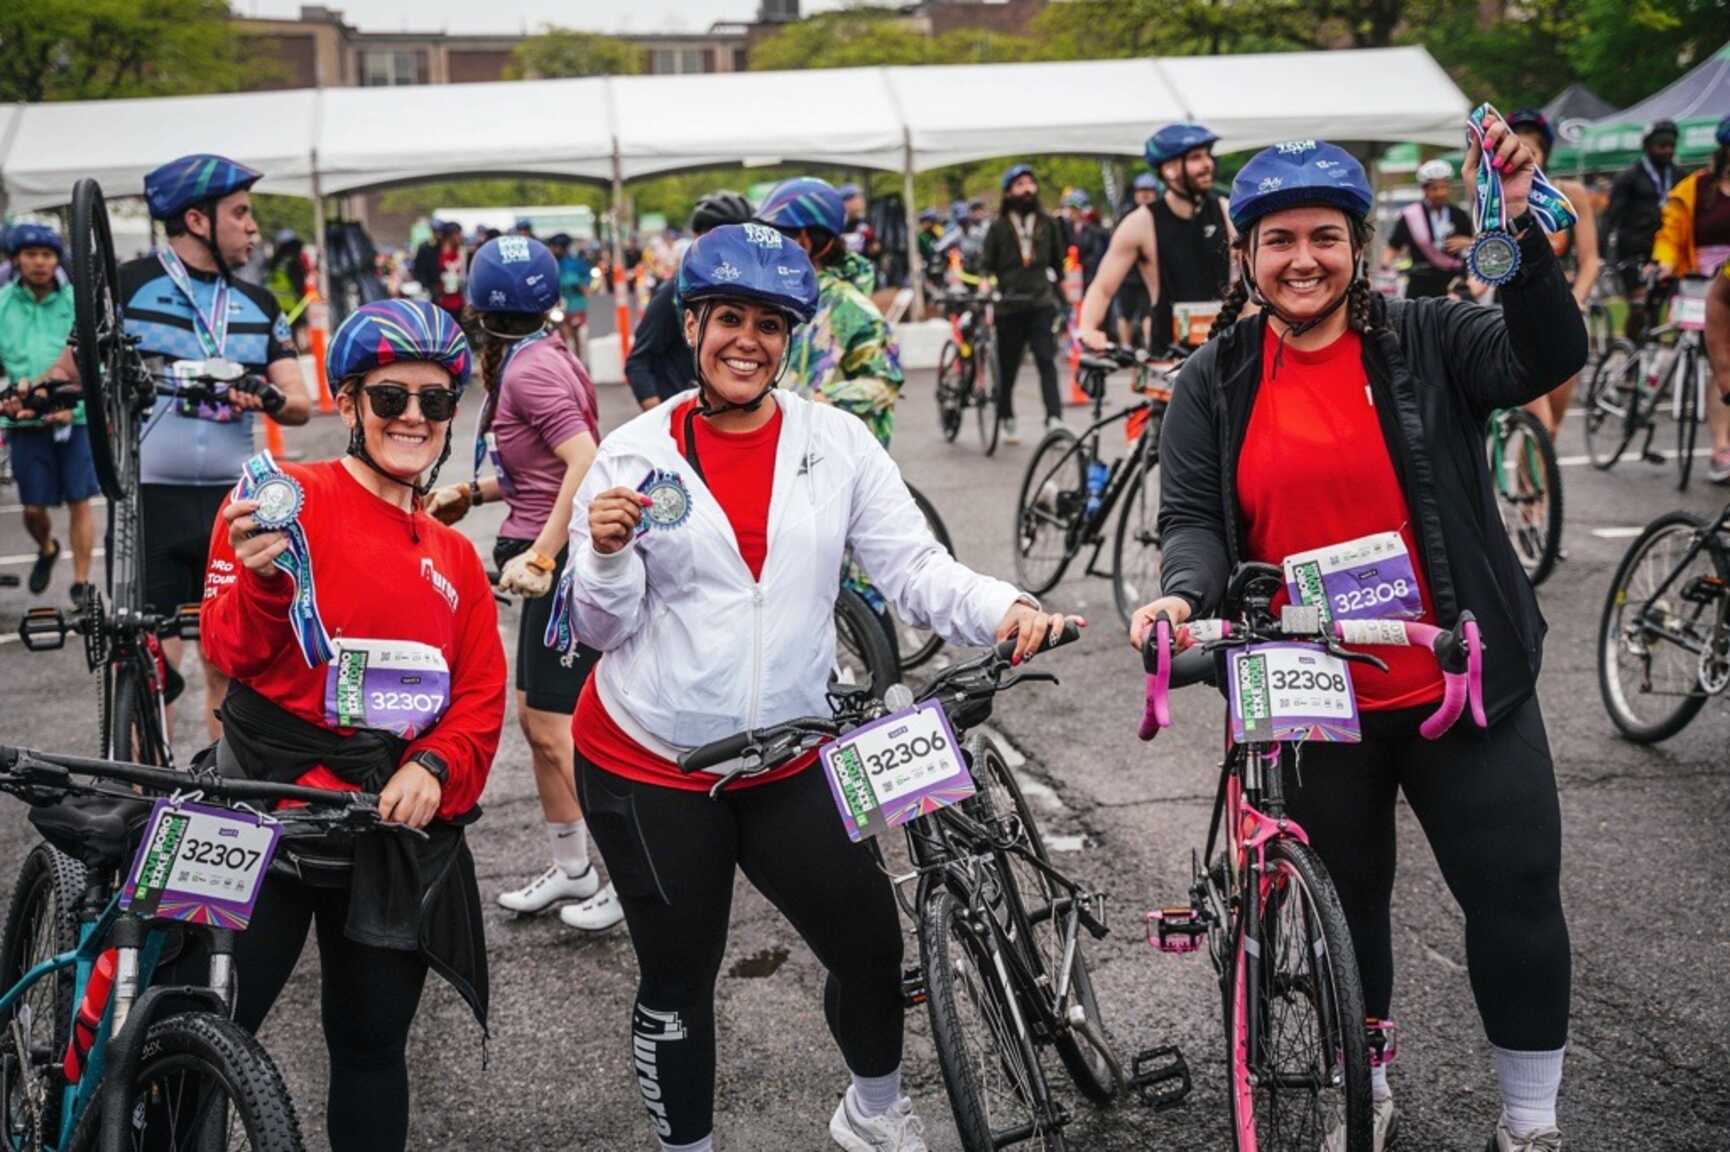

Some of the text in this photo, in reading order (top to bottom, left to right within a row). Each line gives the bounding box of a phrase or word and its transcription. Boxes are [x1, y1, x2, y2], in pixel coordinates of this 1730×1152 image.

[208, 573, 237, 584] TOUR
[1335, 579, 1408, 613] 32308
[1272, 670, 1345, 692] 32308
[370, 692, 445, 714] 32307
[867, 731, 946, 775] 32306
[154, 816, 173, 852] BORO
[150, 850, 171, 889] BIKE
[163, 817, 182, 852] TOUR
[182, 839, 261, 872] 32307
